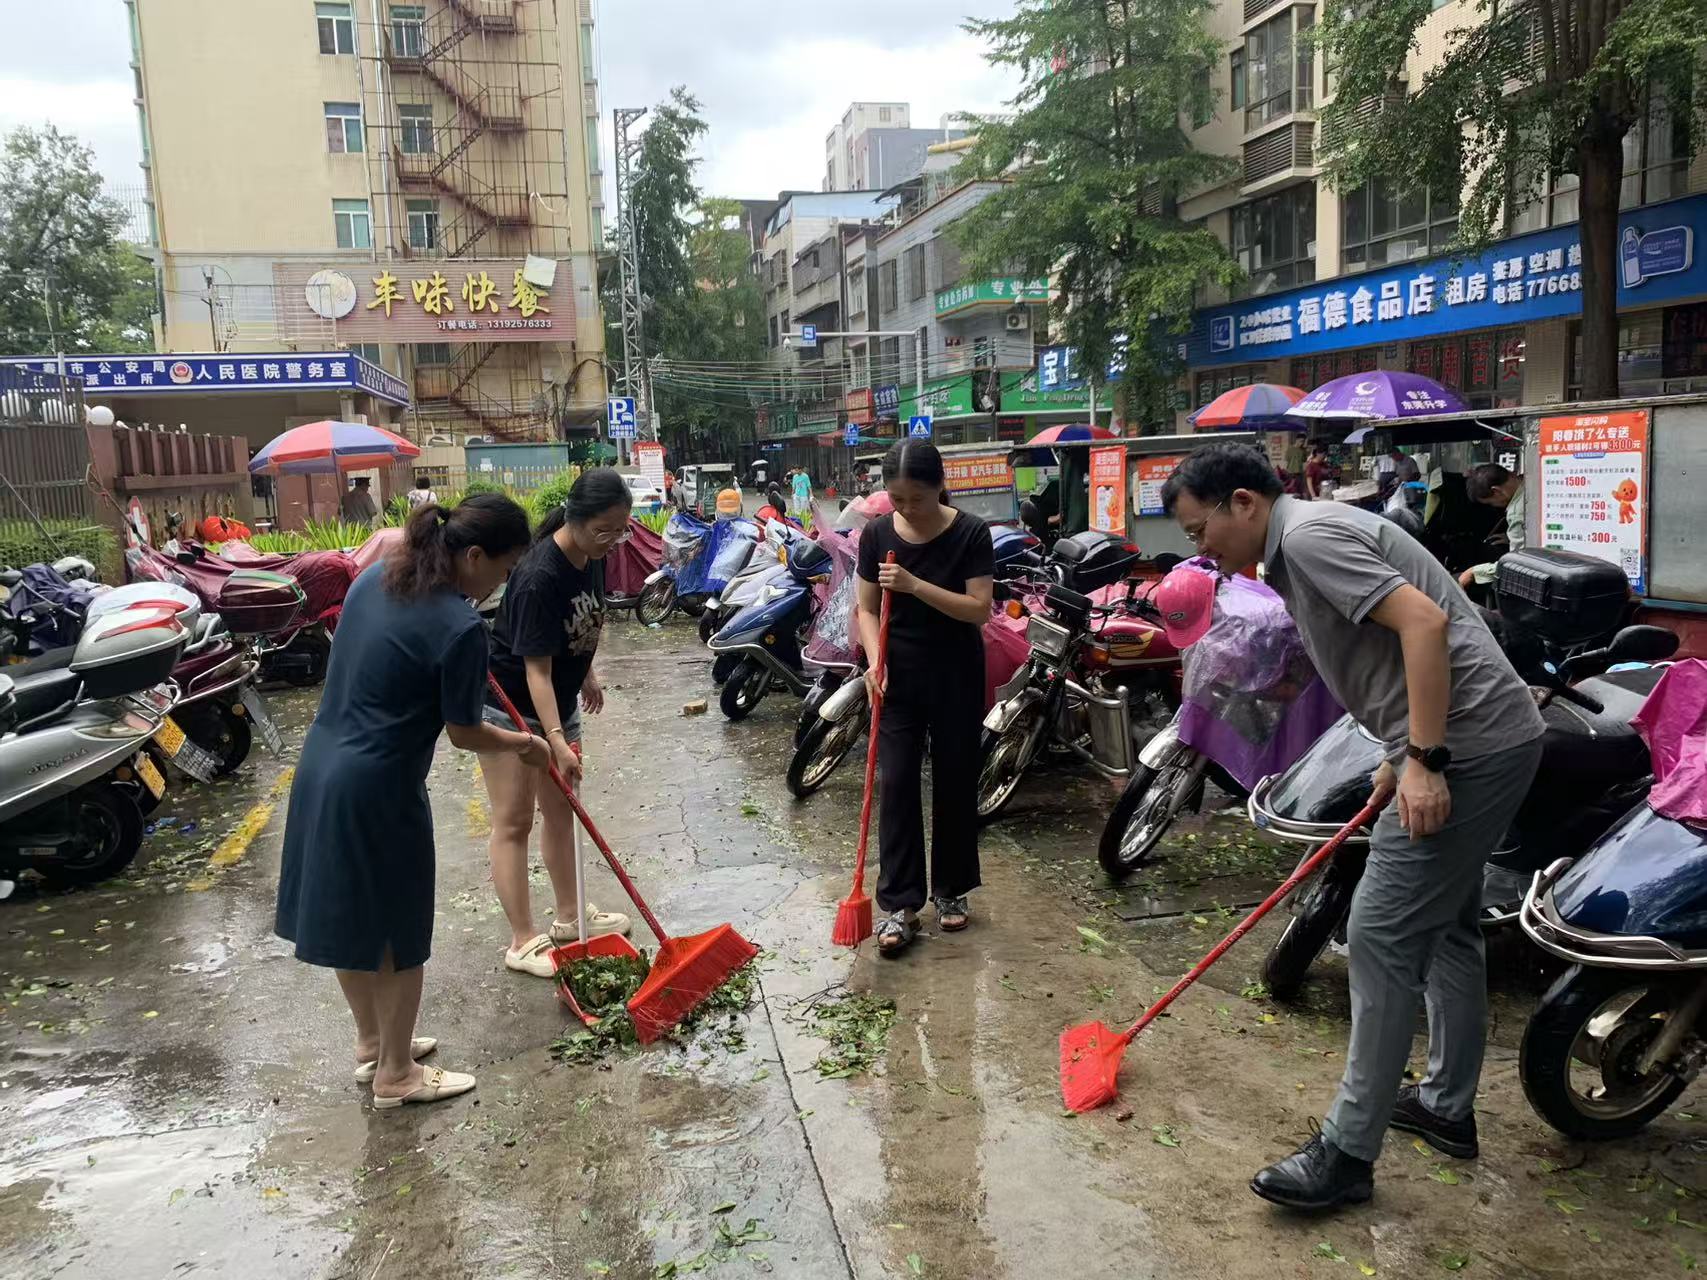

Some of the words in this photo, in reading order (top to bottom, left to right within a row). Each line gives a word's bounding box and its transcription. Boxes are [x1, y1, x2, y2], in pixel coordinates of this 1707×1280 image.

[1298, 273, 1435, 334] 福德食品店
[1445, 272, 1488, 305] 租房
[1529, 247, 1564, 274] 空调
[1493, 281, 1524, 304] 电话
[1527, 272, 1582, 297] 77668
[196, 361, 347, 380] 人民医院警务室
[609, 399, 628, 425] P
[1499, 453, 1516, 473] 店
